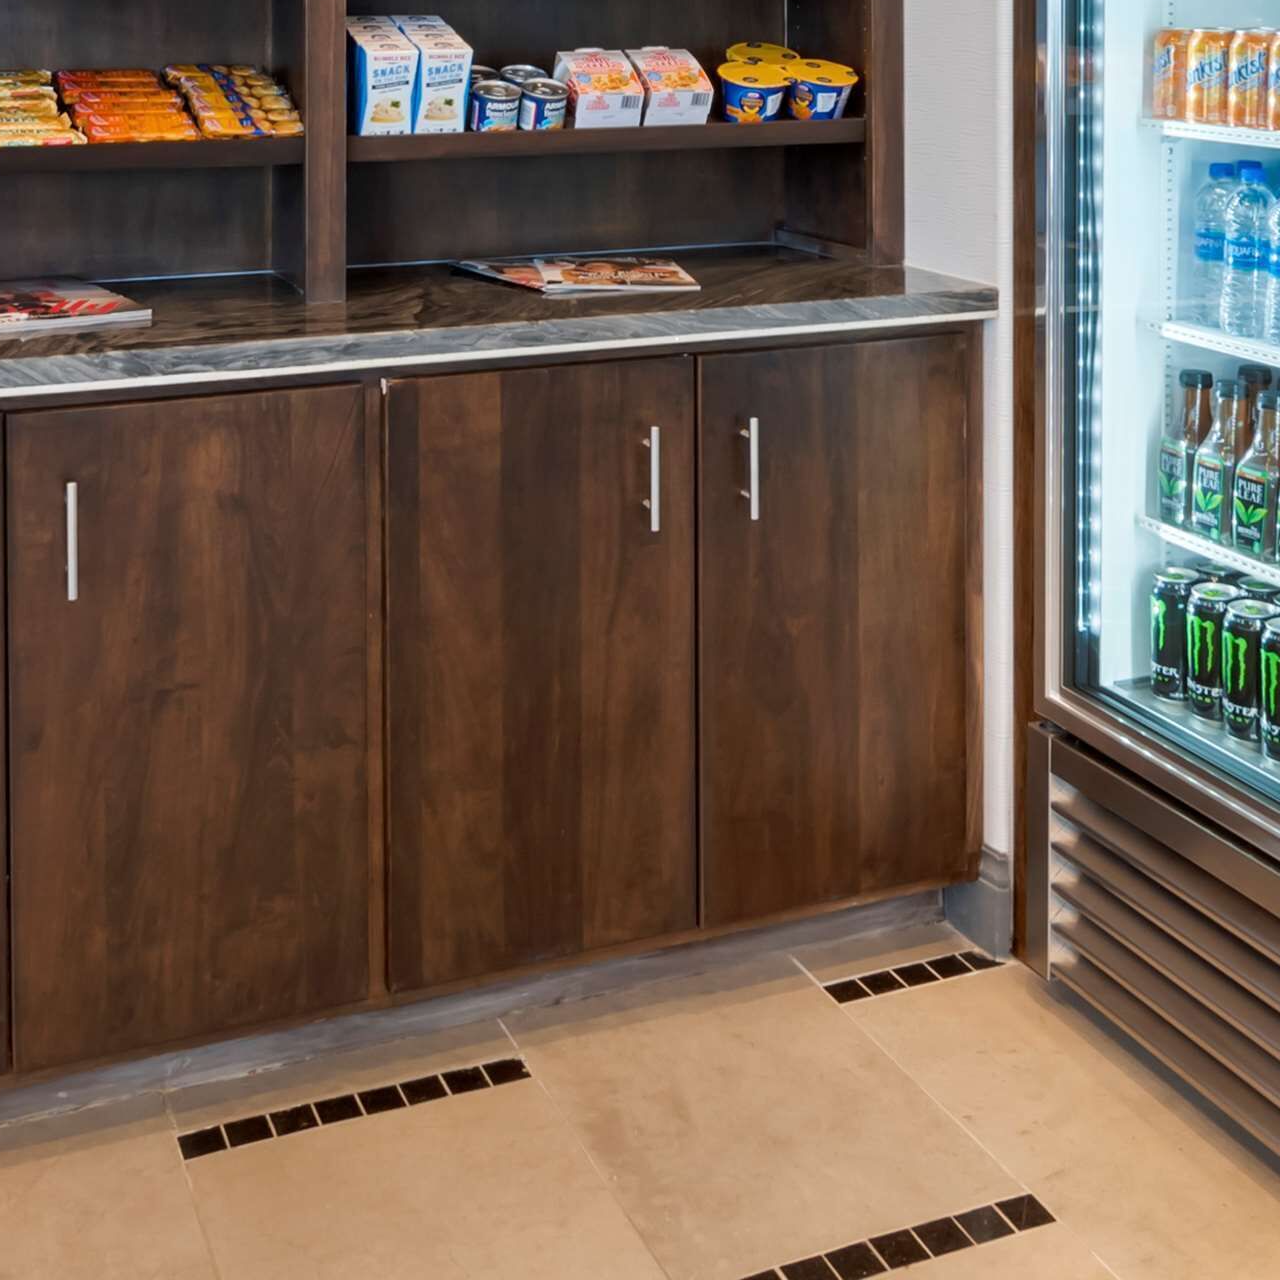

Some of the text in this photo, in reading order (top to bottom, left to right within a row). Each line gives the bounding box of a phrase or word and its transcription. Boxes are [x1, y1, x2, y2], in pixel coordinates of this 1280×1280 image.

[372, 64, 410, 78] SNACK
[427, 63, 465, 76] SNACK
[1238, 477, 1264, 493] PURE
[1237, 488, 1263, 505] LEAF
